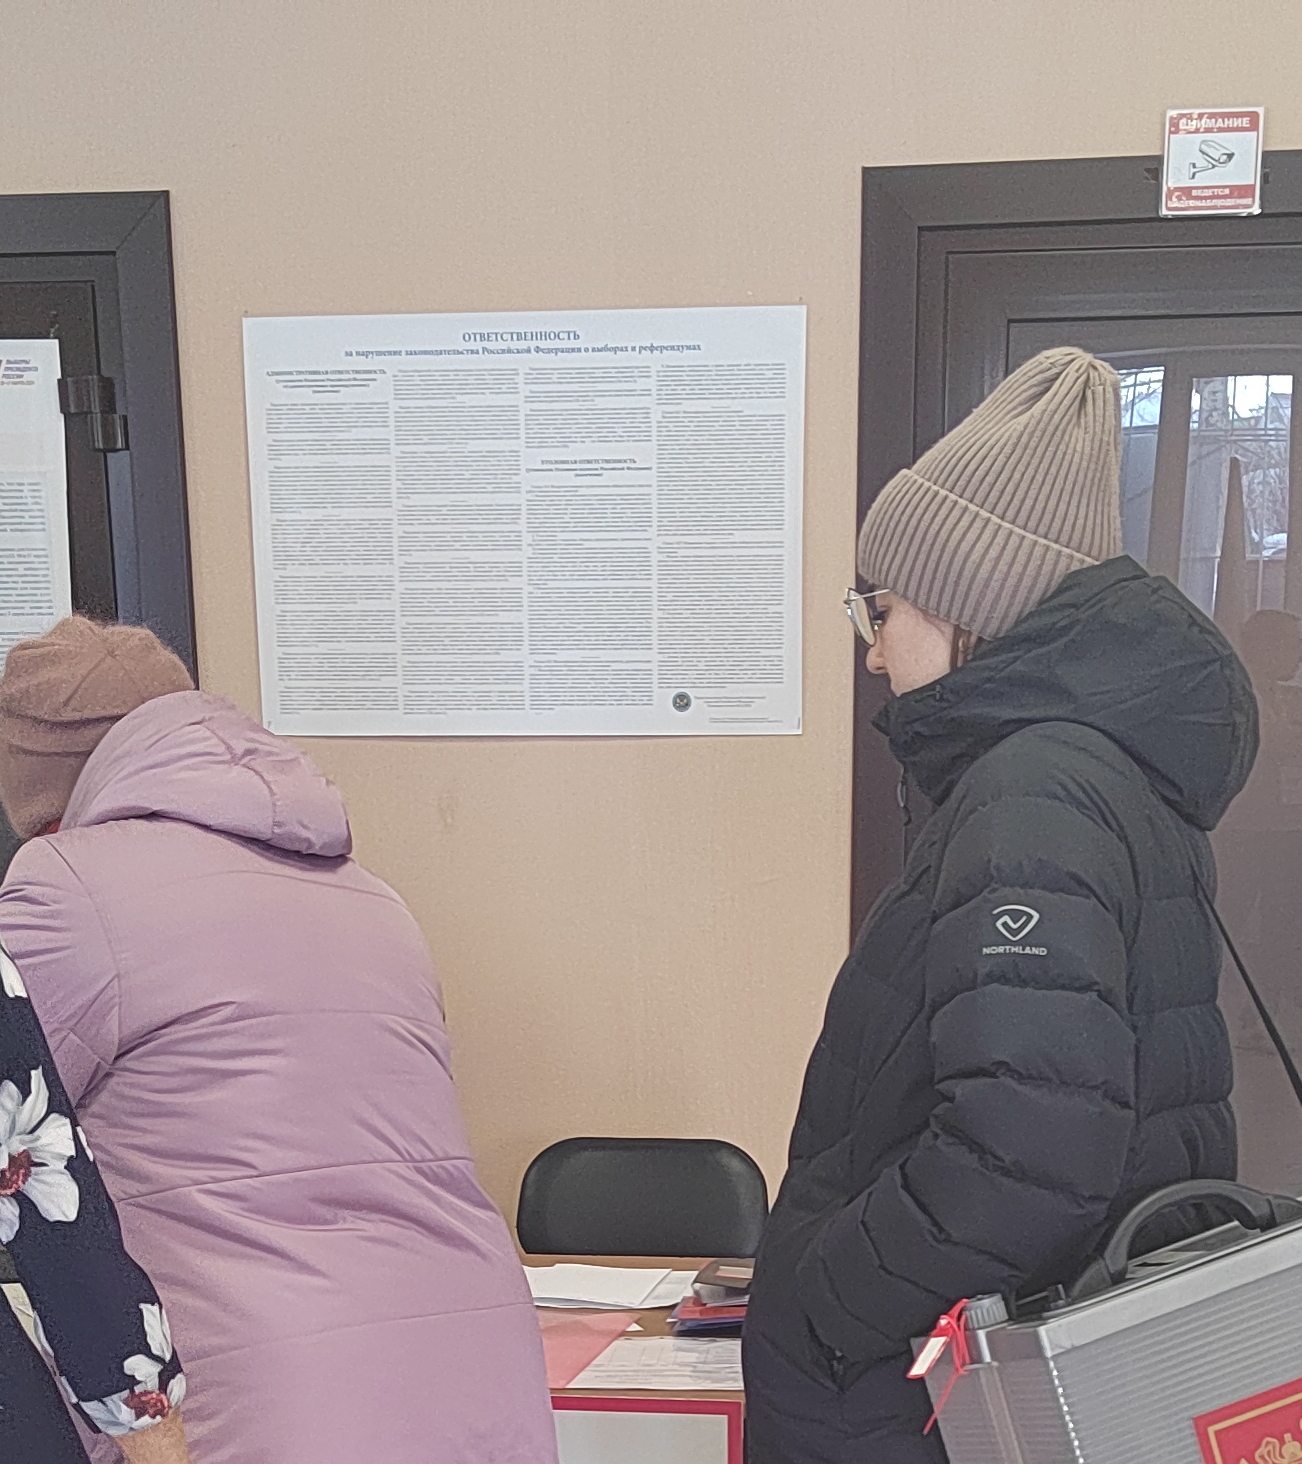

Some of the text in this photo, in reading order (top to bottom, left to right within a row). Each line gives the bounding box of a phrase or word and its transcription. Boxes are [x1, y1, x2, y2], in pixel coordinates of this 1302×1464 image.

[462, 330, 580, 342] ОТВЕТСТВЕННОСТЬ
[355, 349, 403, 361] нарушение
[482, 346, 532, 356] Российской
[533, 345, 582, 356] Федерации
[591, 344, 629, 355] выборах
[638, 343, 702, 355] референдумах
[982, 945, 1048, 956] NORTHLAND
